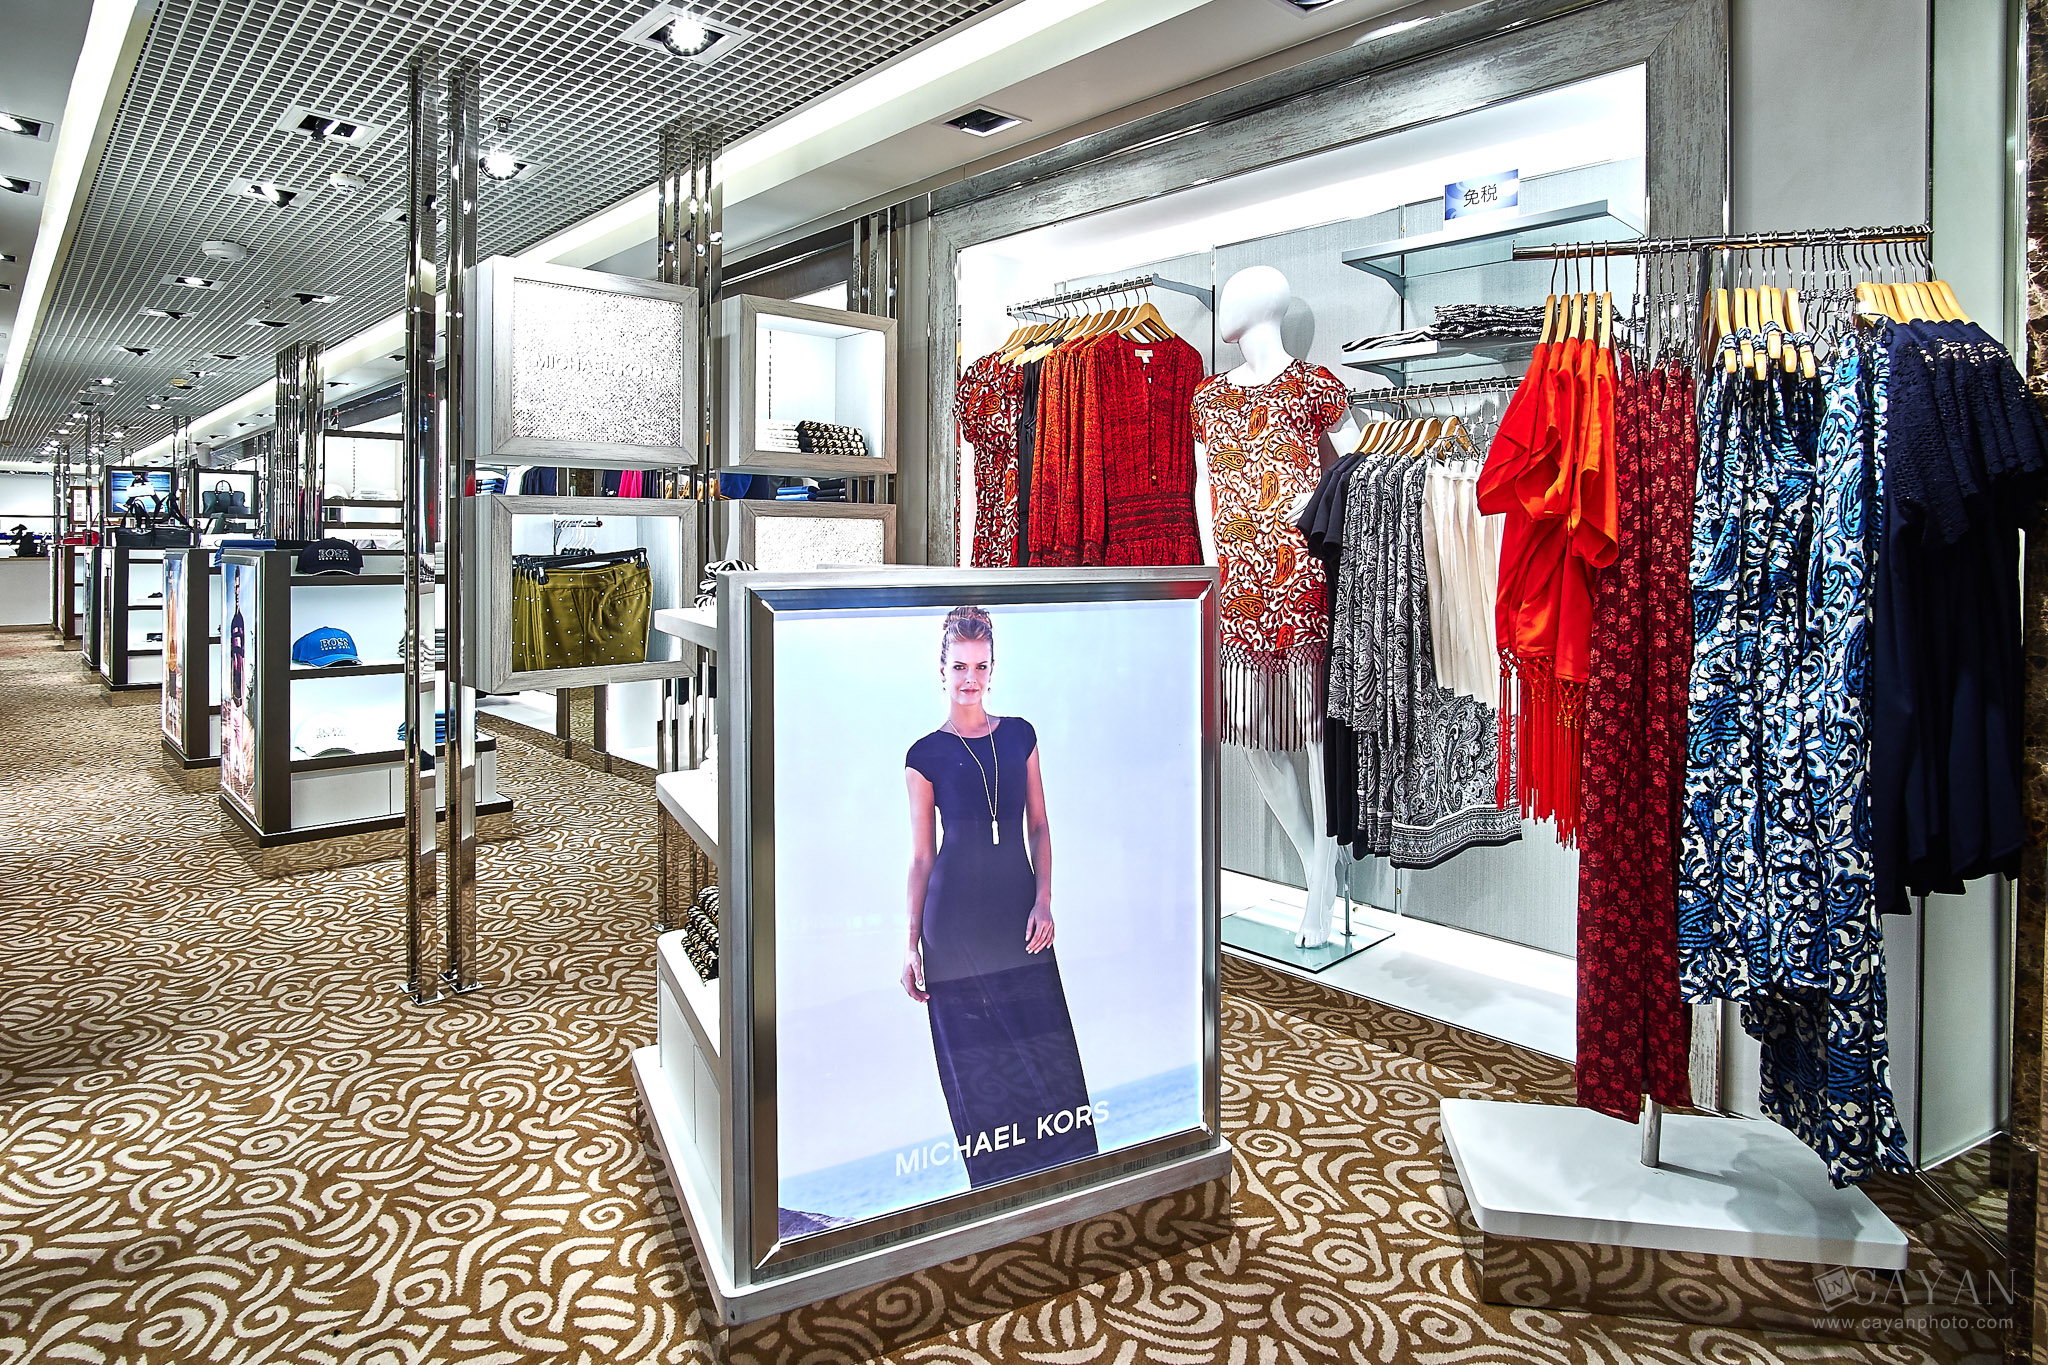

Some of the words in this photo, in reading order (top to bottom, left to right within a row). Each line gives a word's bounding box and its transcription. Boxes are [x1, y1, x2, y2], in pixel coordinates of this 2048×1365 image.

[1463, 183, 1498, 208] 免税
[318, 548, 349, 559] BOSS
[320, 637, 350, 649] BOSS
[895, 1122, 1026, 1177] MICHAEL
[1036, 1100, 1110, 1140] KORS
